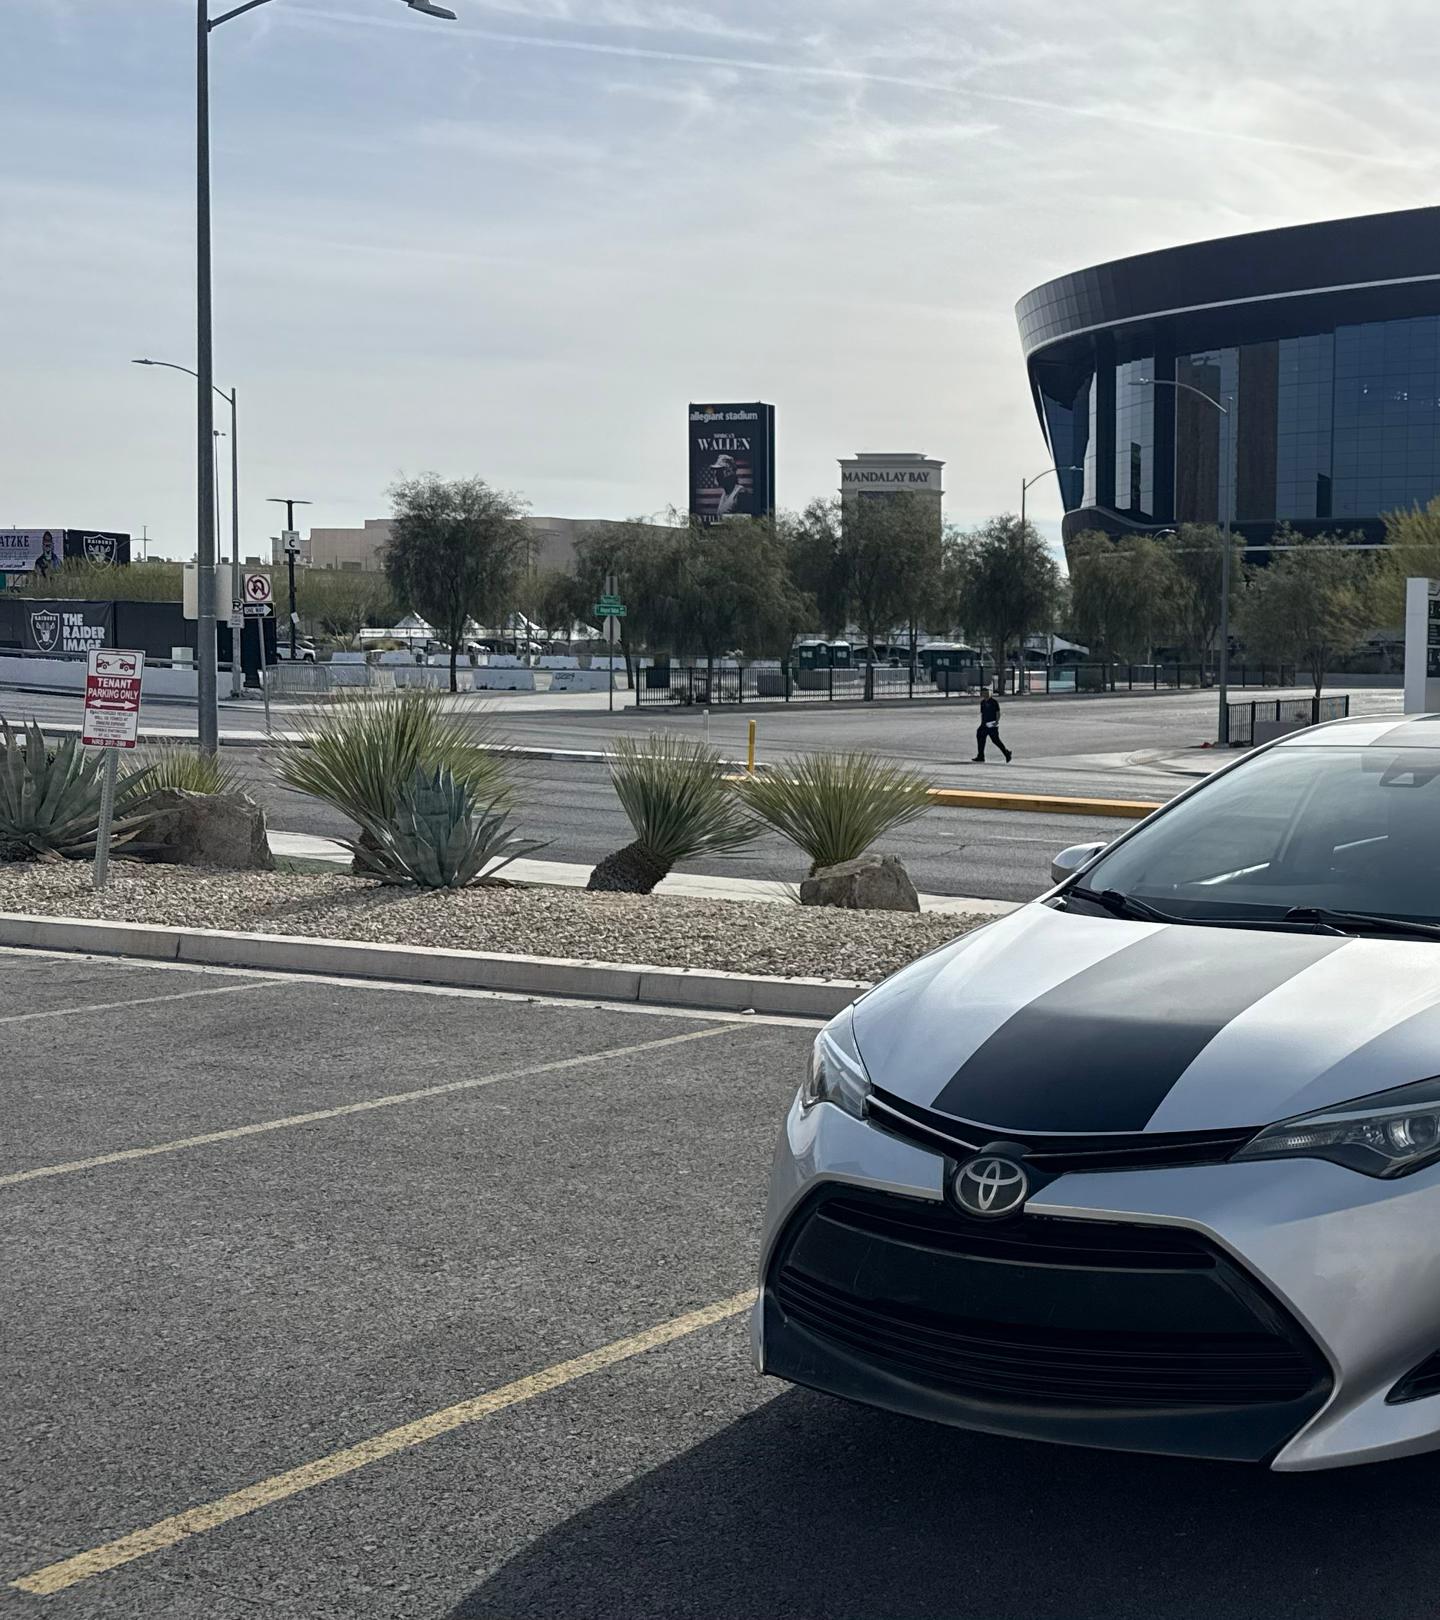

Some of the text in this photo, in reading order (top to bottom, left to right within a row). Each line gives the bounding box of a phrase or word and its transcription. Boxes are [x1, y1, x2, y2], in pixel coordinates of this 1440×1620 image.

[690, 410, 758, 423] allegiant stadium
[697, 438, 751, 450] WALLEN
[842, 471, 930, 482] MANDALAY BAY
[62, 613, 84, 625] THE
[62, 626, 105, 639] RAIDER
[63, 639, 102, 651] IMAGE
[97, 677, 133, 689] TENANT
[87, 687, 139, 700] PARKING ONLY
